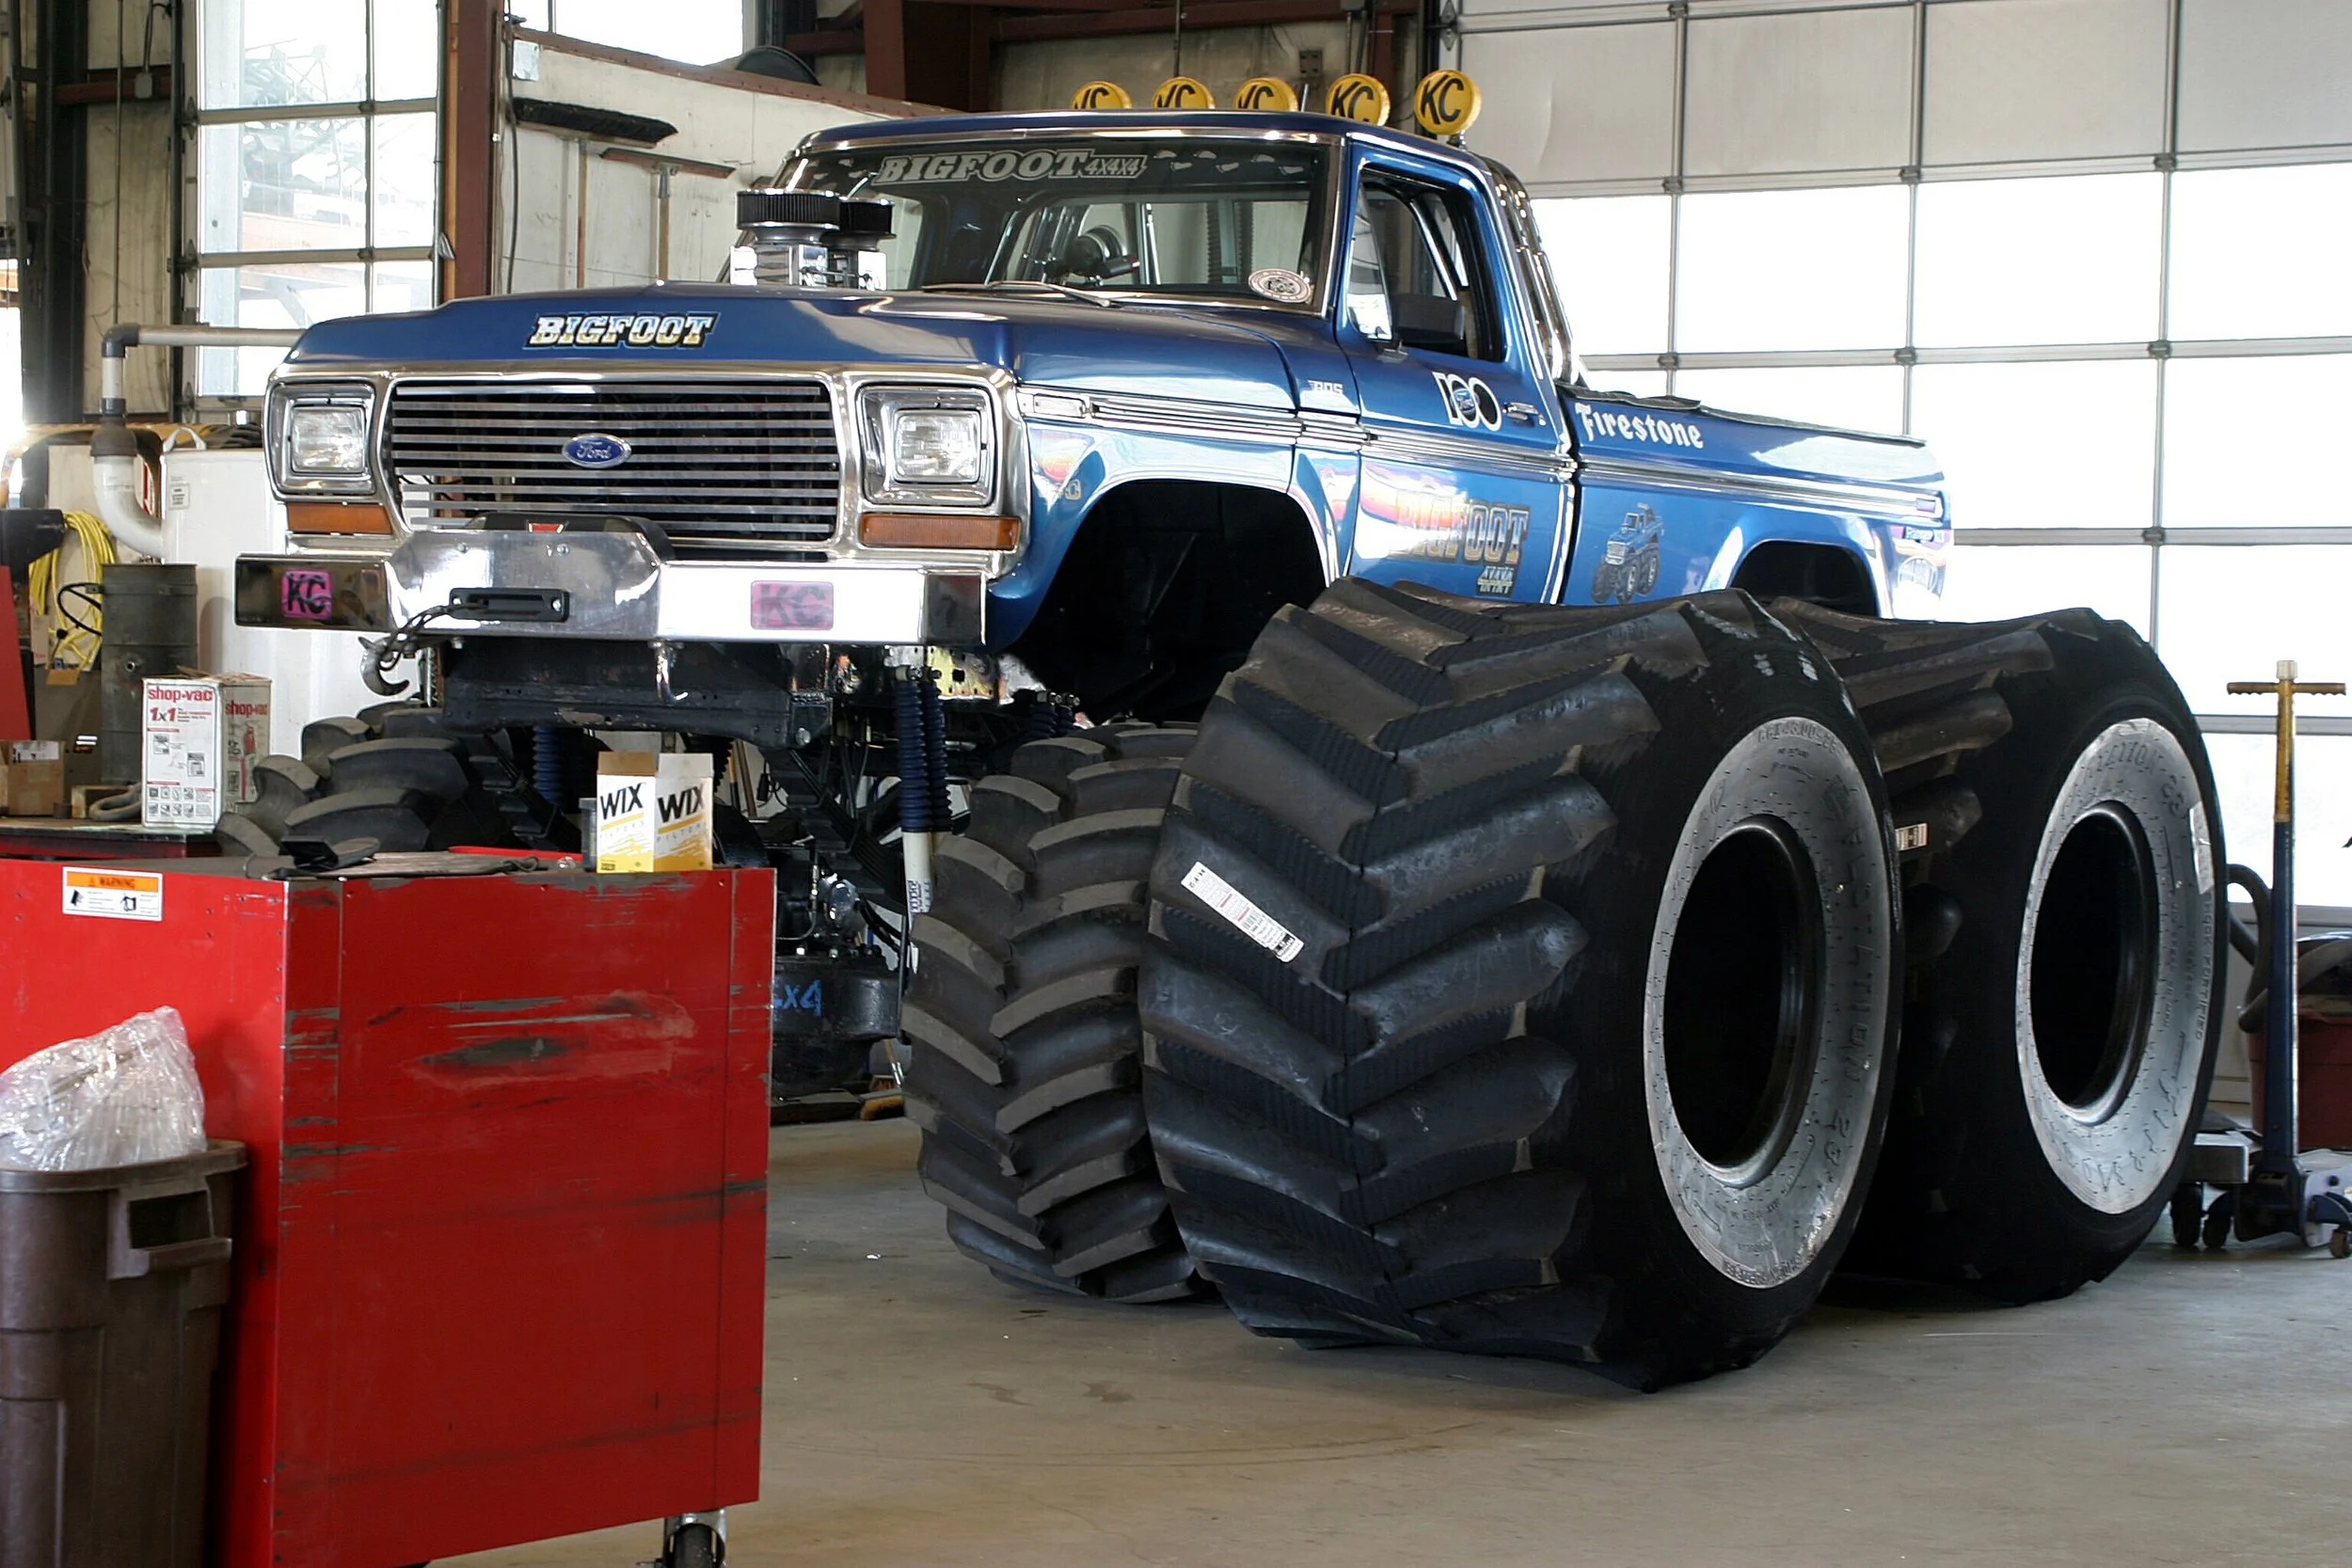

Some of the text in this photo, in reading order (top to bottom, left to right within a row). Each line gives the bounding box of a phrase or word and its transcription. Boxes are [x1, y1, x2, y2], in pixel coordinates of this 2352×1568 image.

[1331, 81, 1374, 121] KC
[1421, 74, 1464, 125] KC
[876, 150, 1140, 183] BIGFOOT 4X4X4
[528, 315, 715, 346] BIGFOOT
[1432, 372, 1502, 432] 100
[1575, 403, 1704, 449] Firestone
[576, 439, 612, 460] Ford
[287, 574, 326, 614] KC
[760, 583, 828, 626] KC
[600, 783, 644, 820] WIX
[658, 786, 704, 823] WIX
